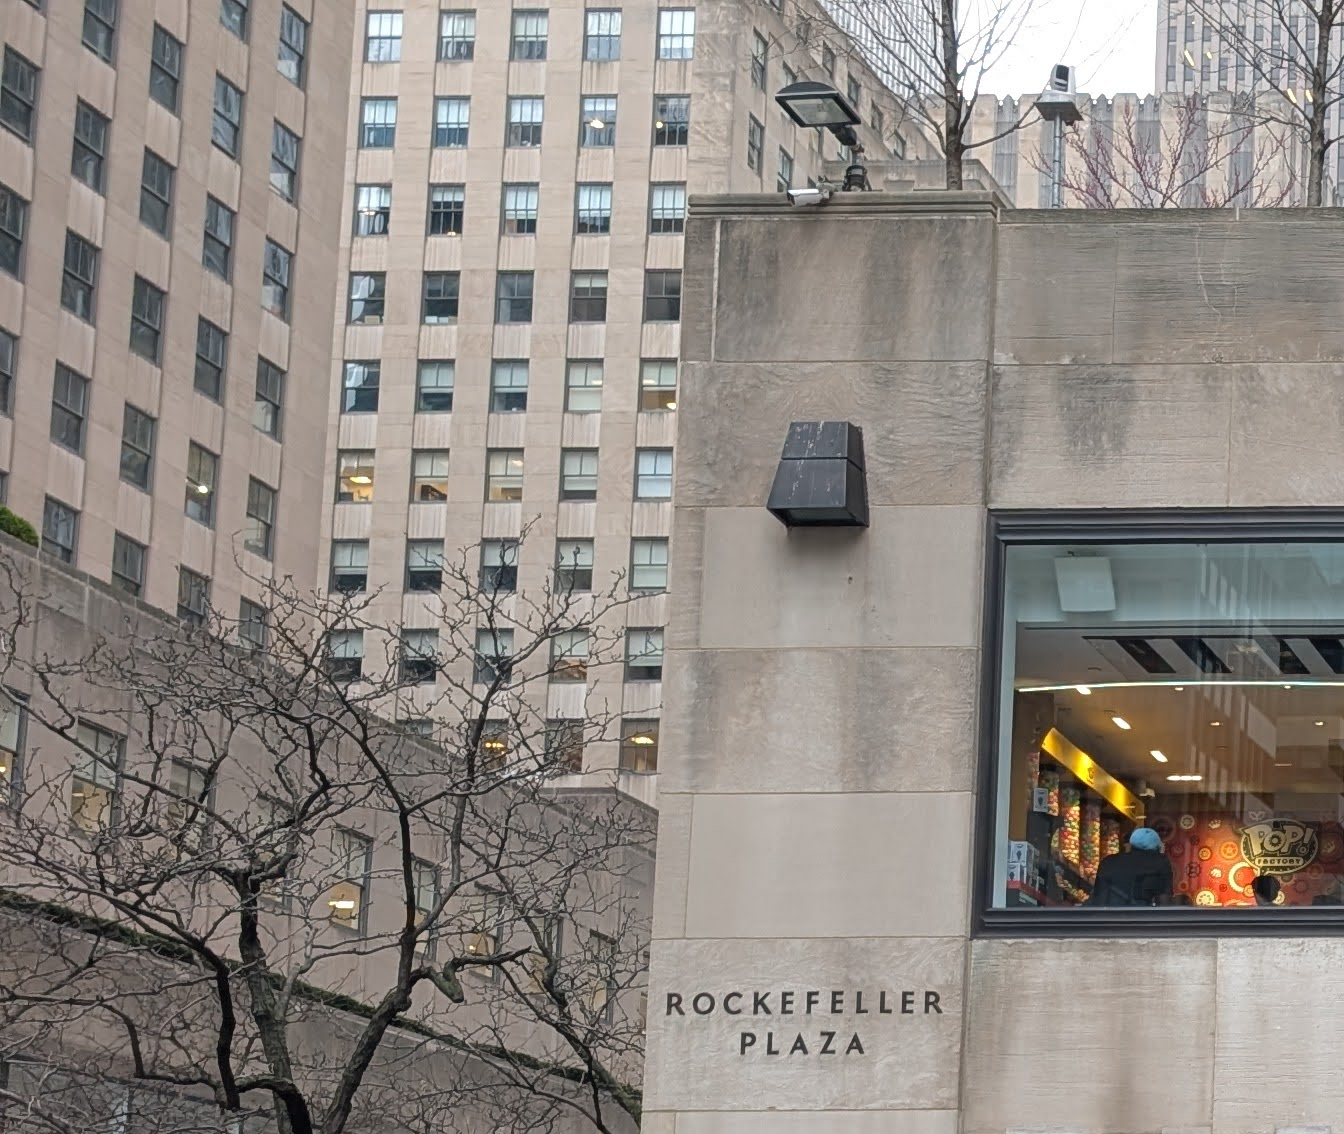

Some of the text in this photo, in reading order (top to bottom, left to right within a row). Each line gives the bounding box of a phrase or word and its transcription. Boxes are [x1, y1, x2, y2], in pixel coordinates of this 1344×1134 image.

[1243, 824, 1314, 857] POP!
[665, 990, 944, 1016] ROCKEFELLER
[739, 1031, 866, 1056] PLAZA
